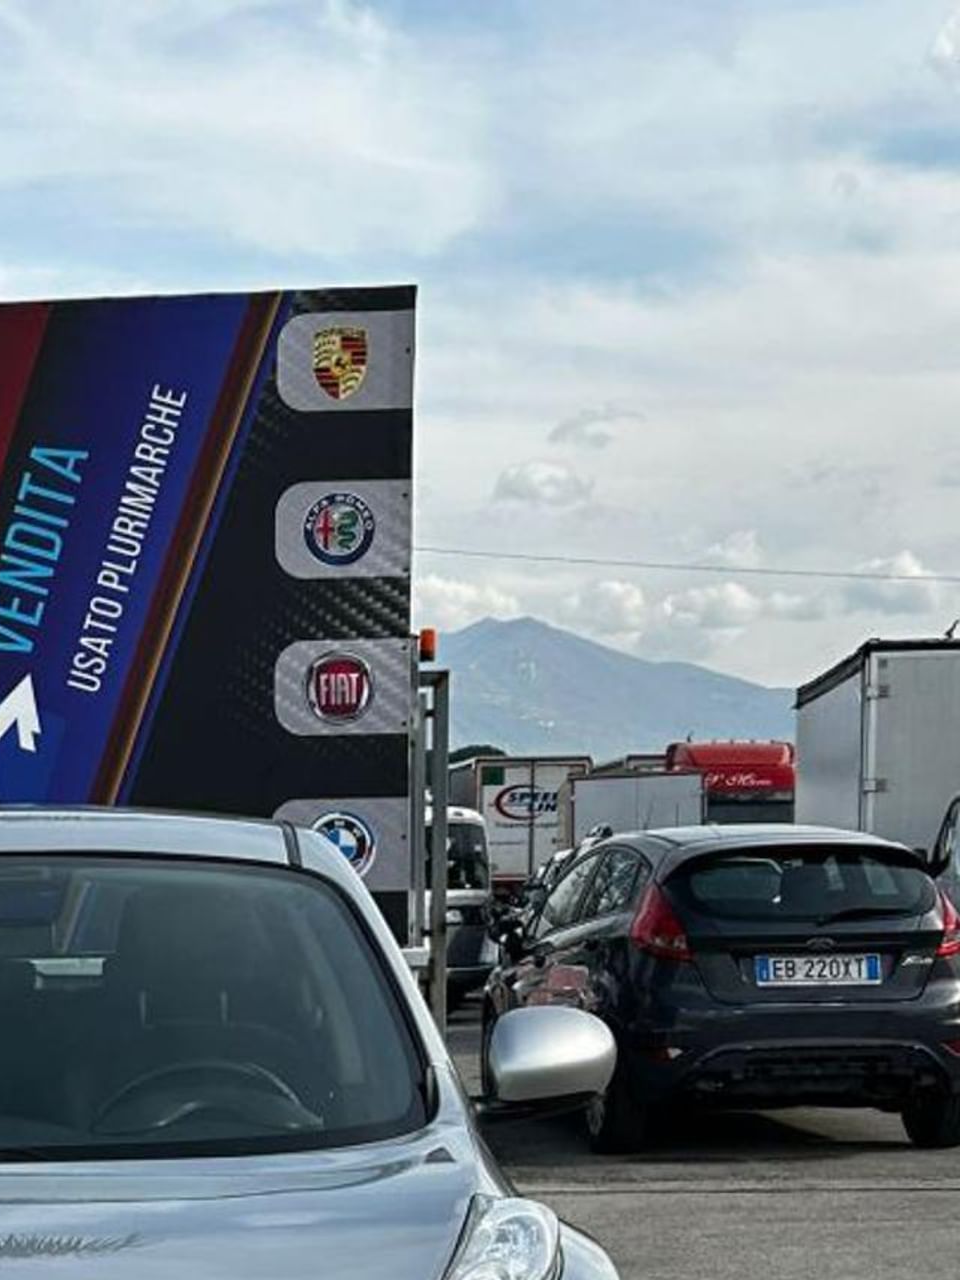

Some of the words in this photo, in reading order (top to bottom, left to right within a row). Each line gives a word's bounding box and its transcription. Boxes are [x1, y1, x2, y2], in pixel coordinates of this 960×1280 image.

[67, 596, 123, 693] USATO
[97, 384, 188, 592] PLURIMARCHE
[320, 672, 360, 706] FIAT
[772, 959, 796, 979] EB
[804, 957, 865, 979] 220XT
